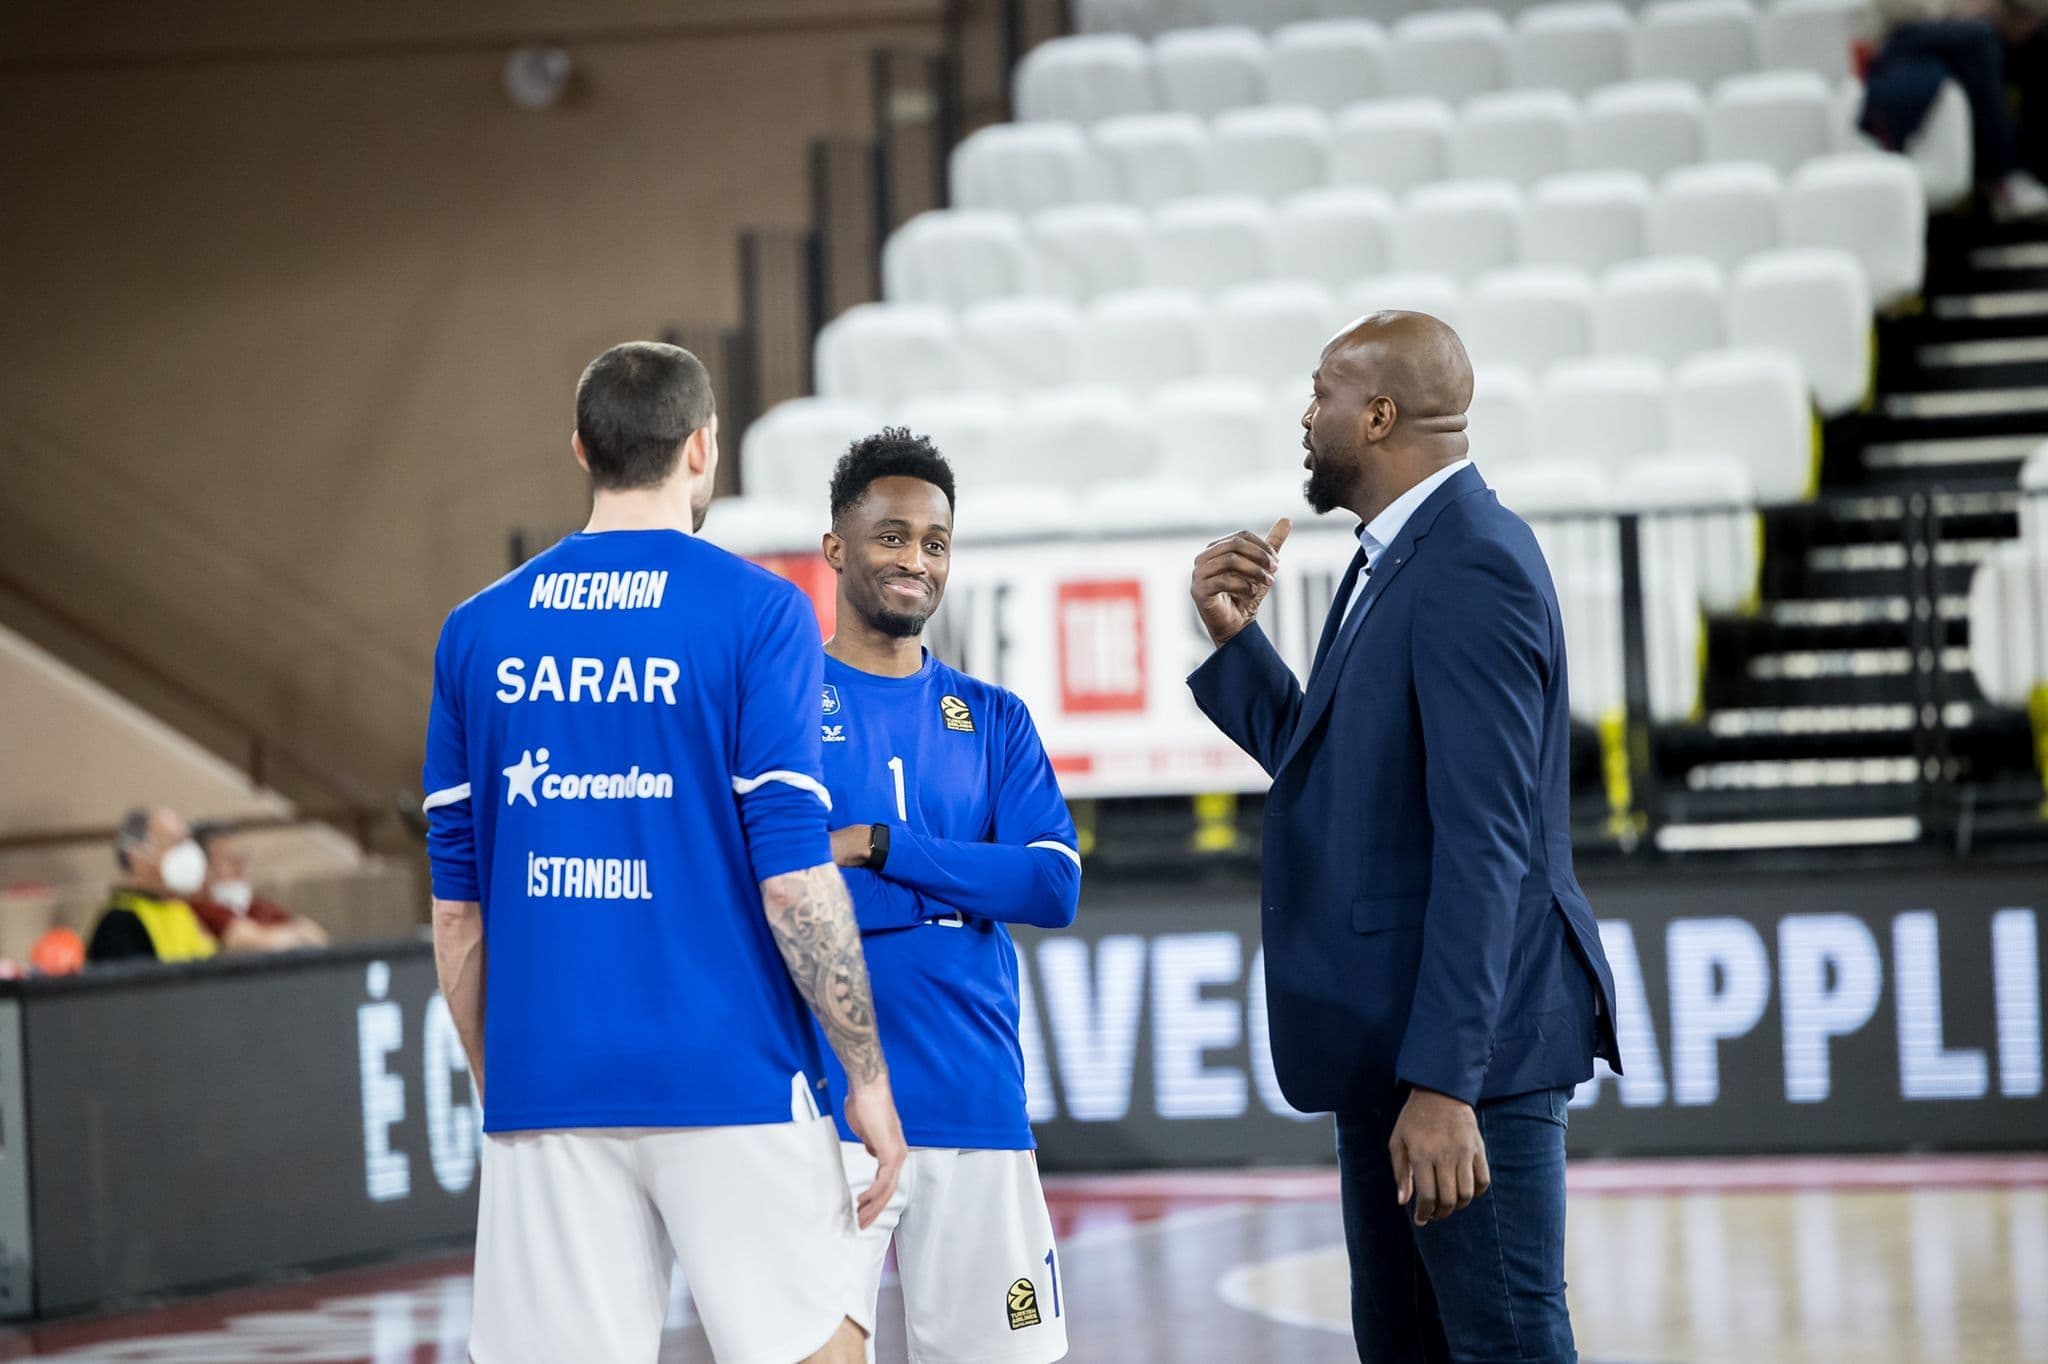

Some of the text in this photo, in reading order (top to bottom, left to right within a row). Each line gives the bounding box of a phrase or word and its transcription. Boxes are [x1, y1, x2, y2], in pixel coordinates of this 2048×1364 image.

[529, 571, 668, 610] MOERMAN
[495, 655, 681, 705] SARAR
[542, 765, 674, 800] corendon
[888, 756, 907, 822] 1
[528, 850, 653, 900] İSTANBUL
[1044, 1248, 1061, 1318] 1
